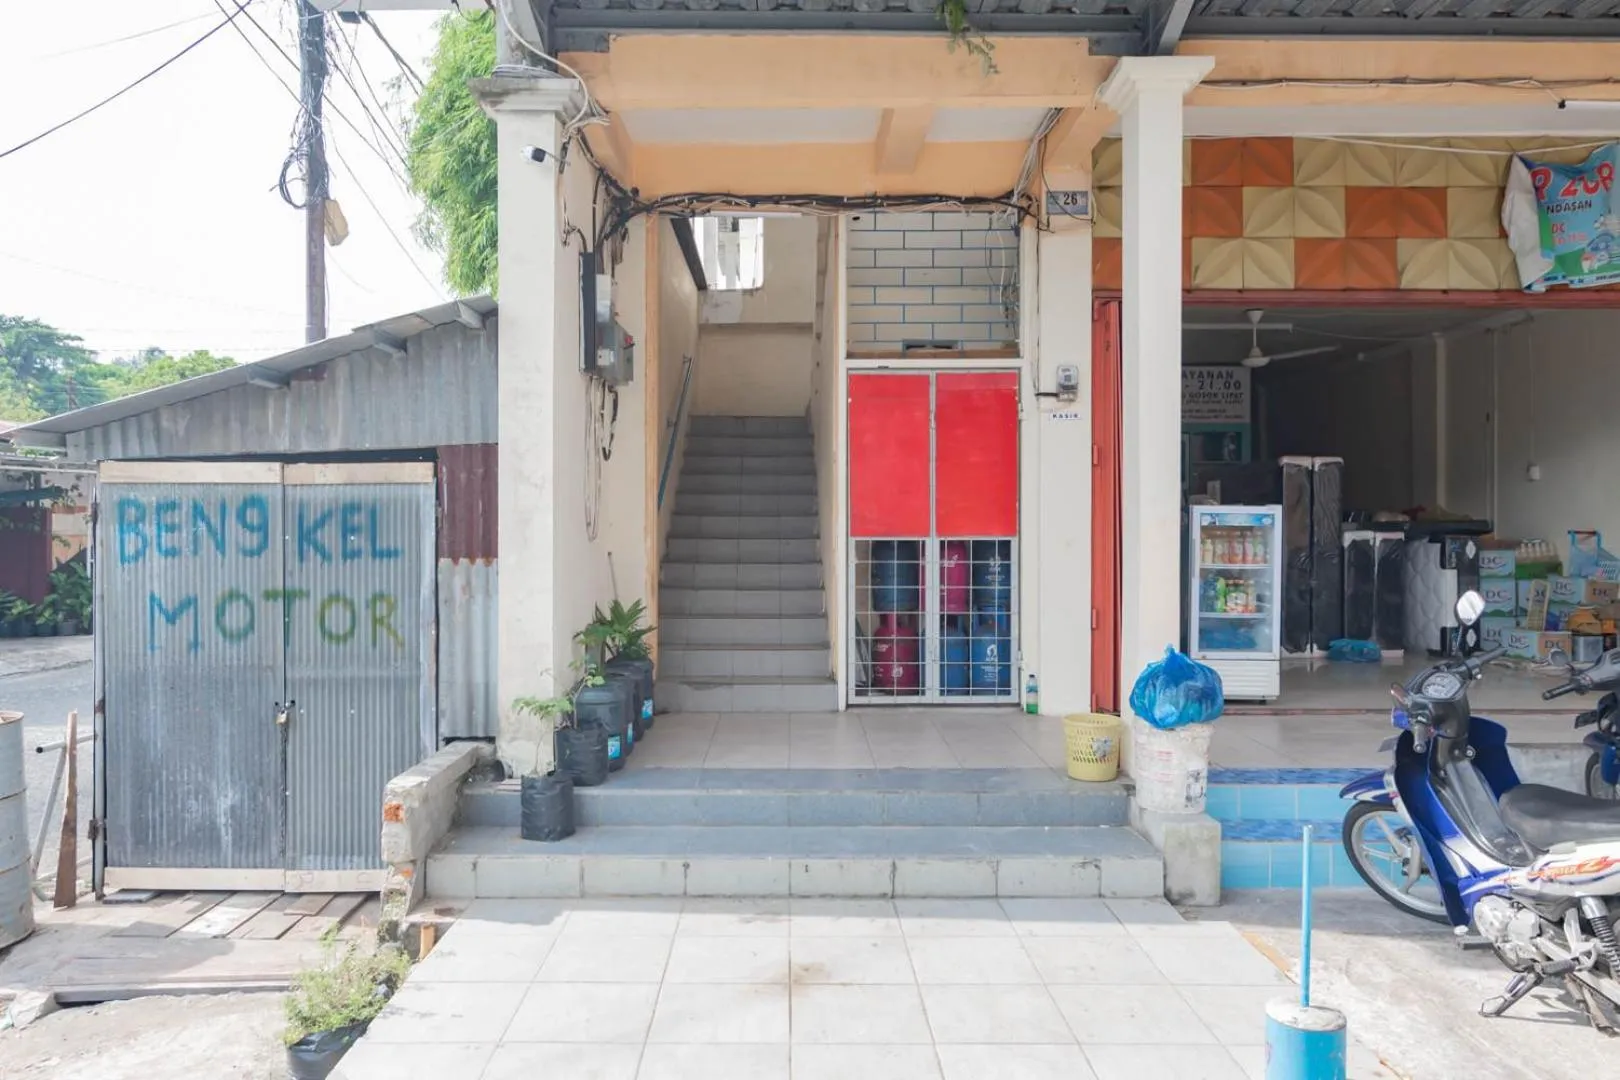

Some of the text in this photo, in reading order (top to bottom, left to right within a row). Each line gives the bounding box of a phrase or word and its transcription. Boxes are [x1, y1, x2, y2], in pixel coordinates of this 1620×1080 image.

[1063, 192, 1078, 206] 26
[1547, 200, 1592, 214] NDASAN
[1480, 556, 1502, 565] DC
[1555, 581, 1573, 591] DC
[1485, 590, 1508, 599] DC
[148, 587, 404, 655] MOTOR
[1510, 635, 1527, 645] DC
[1544, 639, 1564, 649] DC
